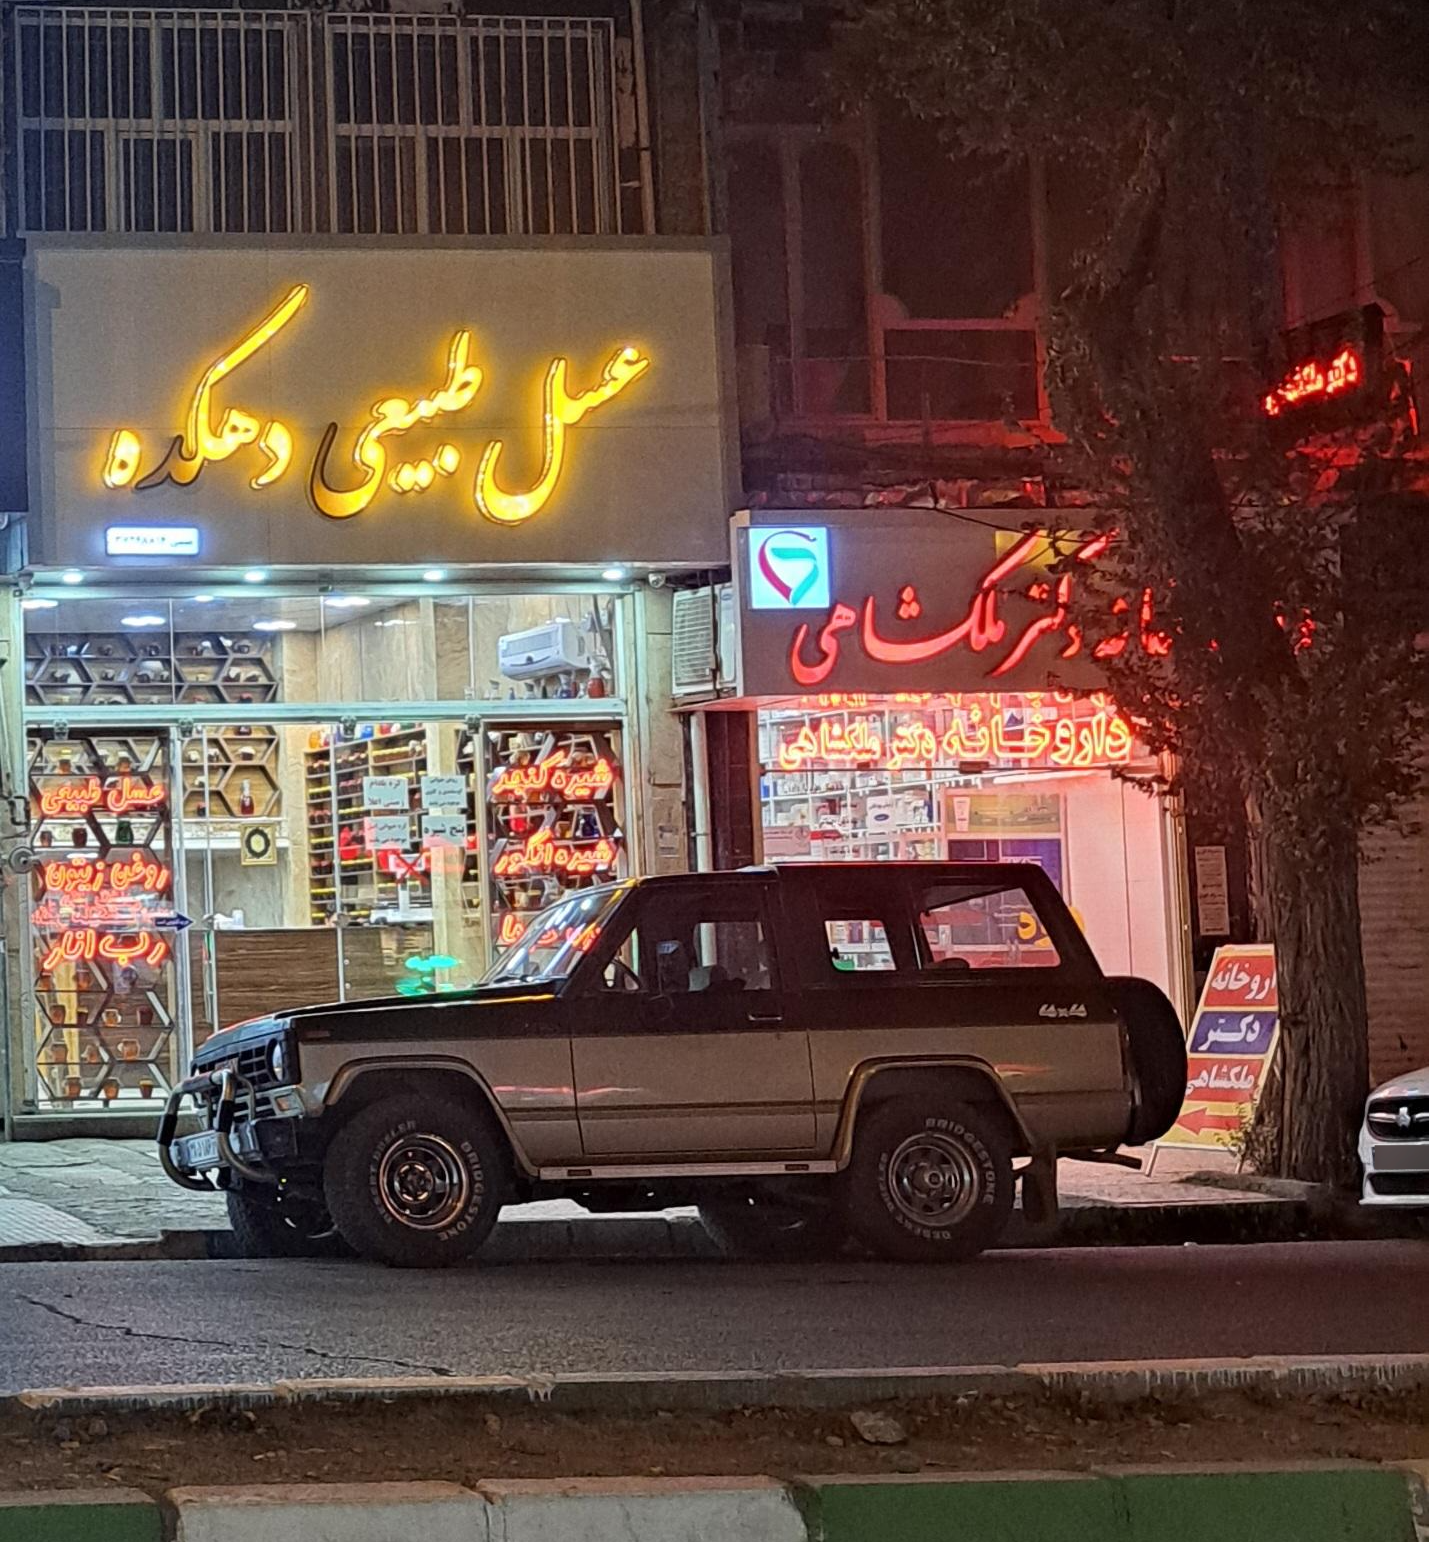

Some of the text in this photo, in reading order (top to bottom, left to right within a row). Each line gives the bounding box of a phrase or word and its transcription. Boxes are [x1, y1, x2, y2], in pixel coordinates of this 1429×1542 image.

[100, 281, 651, 526] عسل طبیعی دهکده
[791, 526, 1042, 686] ملکشاهی
[778, 716, 882, 771] ملکشاهی
[885, 720, 936, 770] دکتر
[40, 776, 166, 816] عسل طبیعی
[491, 749, 613, 797] شیره کنجد
[44, 851, 170, 893] روغن زیتون
[493, 826, 613, 875] شیره انگور
[42, 929, 167, 970] رب انار
[1211, 962, 1278, 1001] اروخانه
[1197, 1013, 1261, 1051] دکتر
[1184, 1062, 1256, 1097] ملکشاهی
[924, 1117, 997, 1205] BRIDGESTONE
[437, 1141, 485, 1242] BRIDGESTONE
